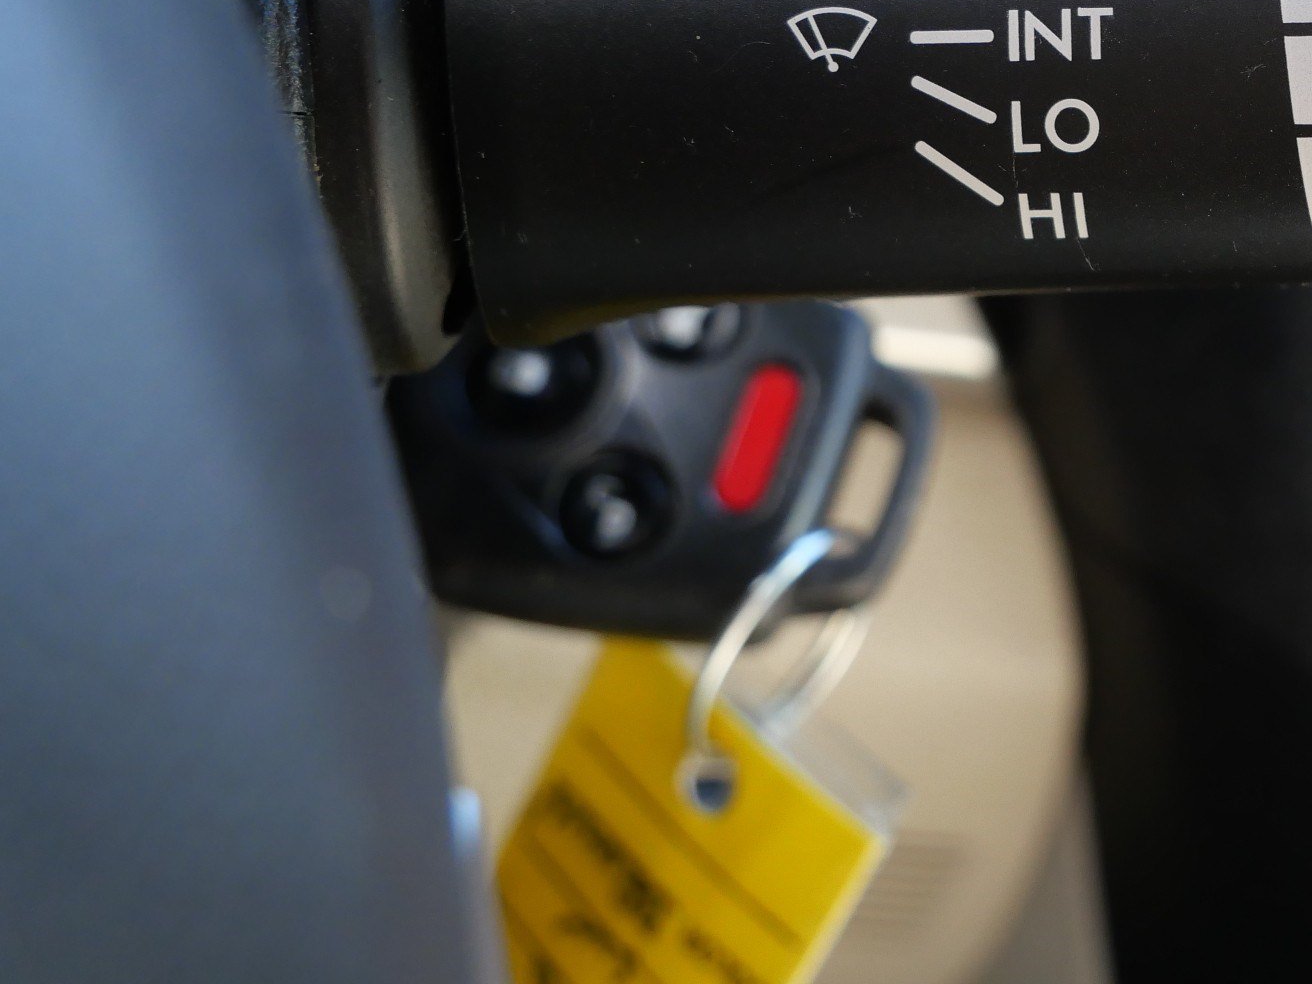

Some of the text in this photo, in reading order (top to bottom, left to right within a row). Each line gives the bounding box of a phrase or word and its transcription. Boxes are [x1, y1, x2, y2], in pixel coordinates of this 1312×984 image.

[1007, 7, 1114, 62] INT
[1010, 98, 1100, 153] LO
[1018, 192, 1089, 240] HI
